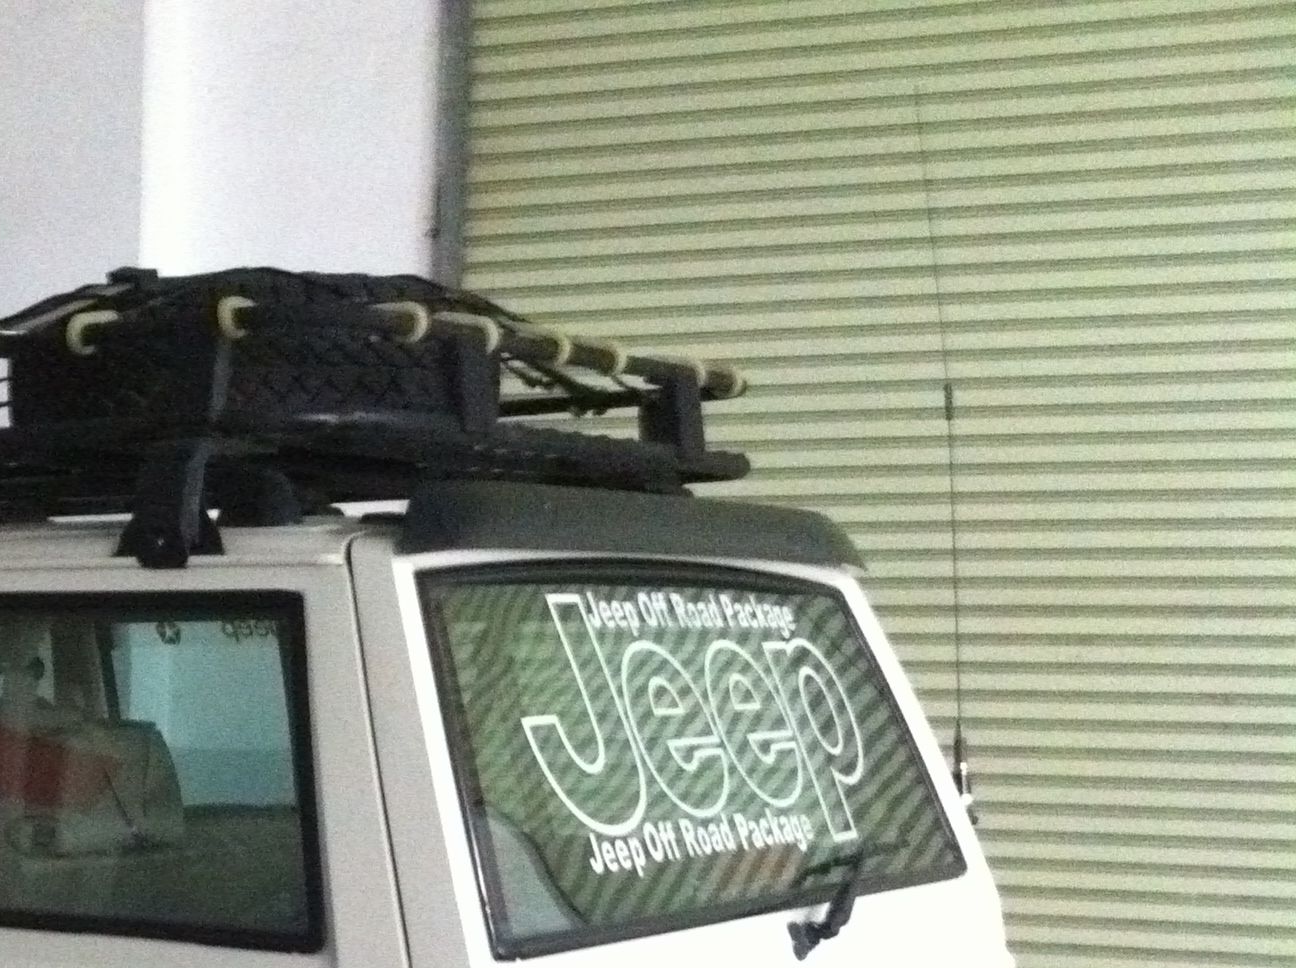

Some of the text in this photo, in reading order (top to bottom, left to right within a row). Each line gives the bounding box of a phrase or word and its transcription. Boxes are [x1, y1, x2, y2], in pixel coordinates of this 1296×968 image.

[586, 591, 796, 637] Jeep Off Road Package
[521, 593, 864, 841] Jeep
[588, 811, 814, 876] Jeep Off Road Package
